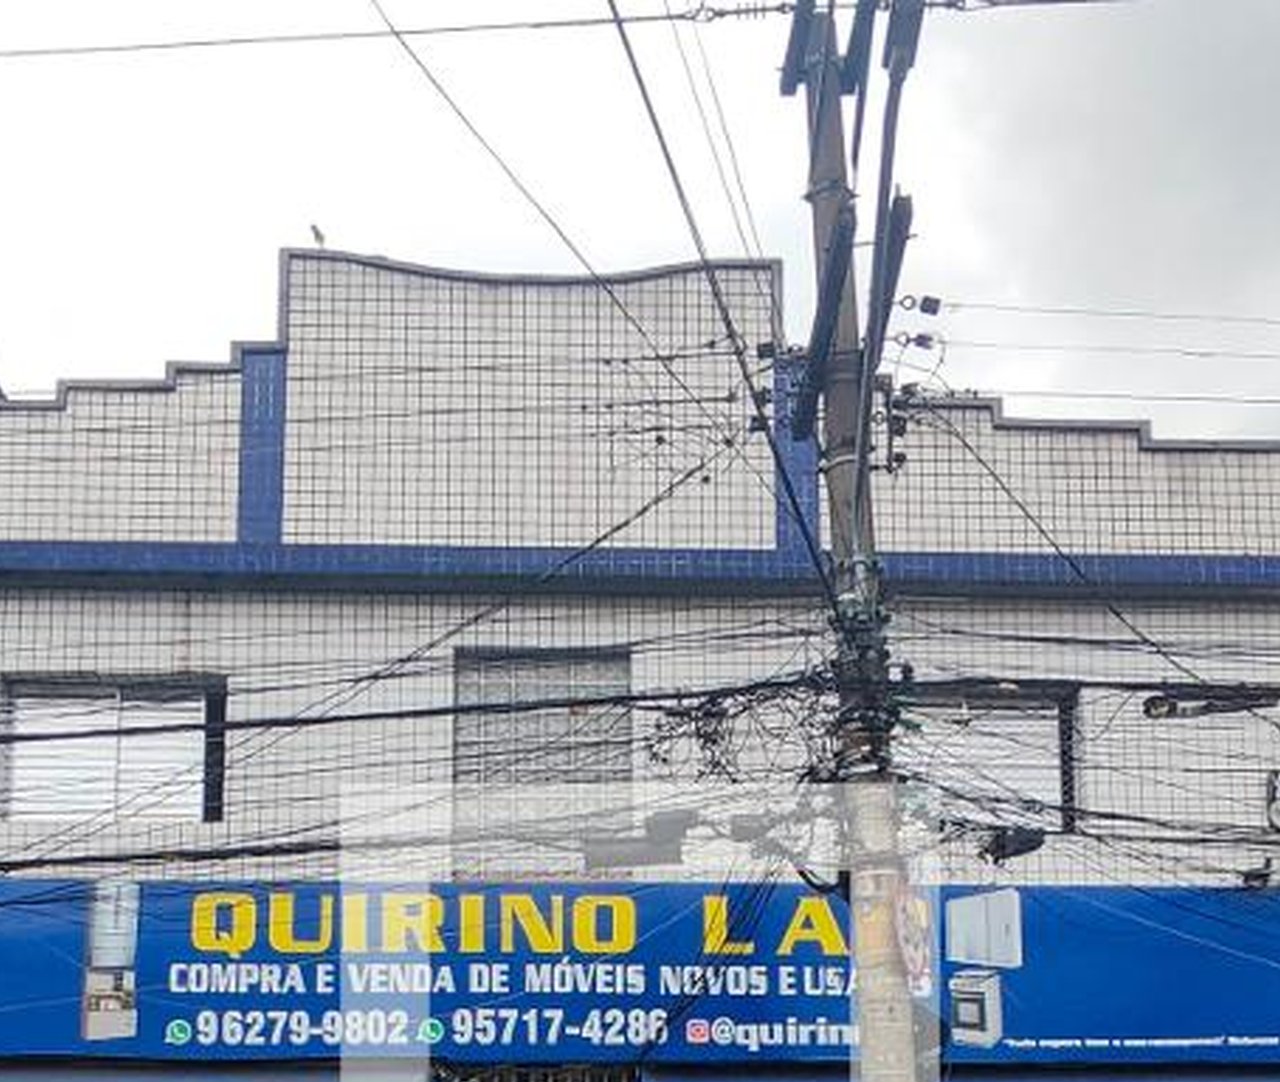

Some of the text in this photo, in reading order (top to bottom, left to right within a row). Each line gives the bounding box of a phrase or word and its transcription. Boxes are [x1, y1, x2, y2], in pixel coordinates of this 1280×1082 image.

[191, 891, 926, 959] QUIRINO LA
[169, 963, 306, 994] COMPRA
[316, 963, 334, 994] E
[347, 963, 456, 994] VENDA
[469, 963, 510, 994] DE
[525, 955, 645, 994] MÓVEIS
[660, 966, 768, 996] NOVOS
[779, 966, 797, 995] E
[197, 1008, 861, 1051] 96279-9802 95717-4286 @quirin
